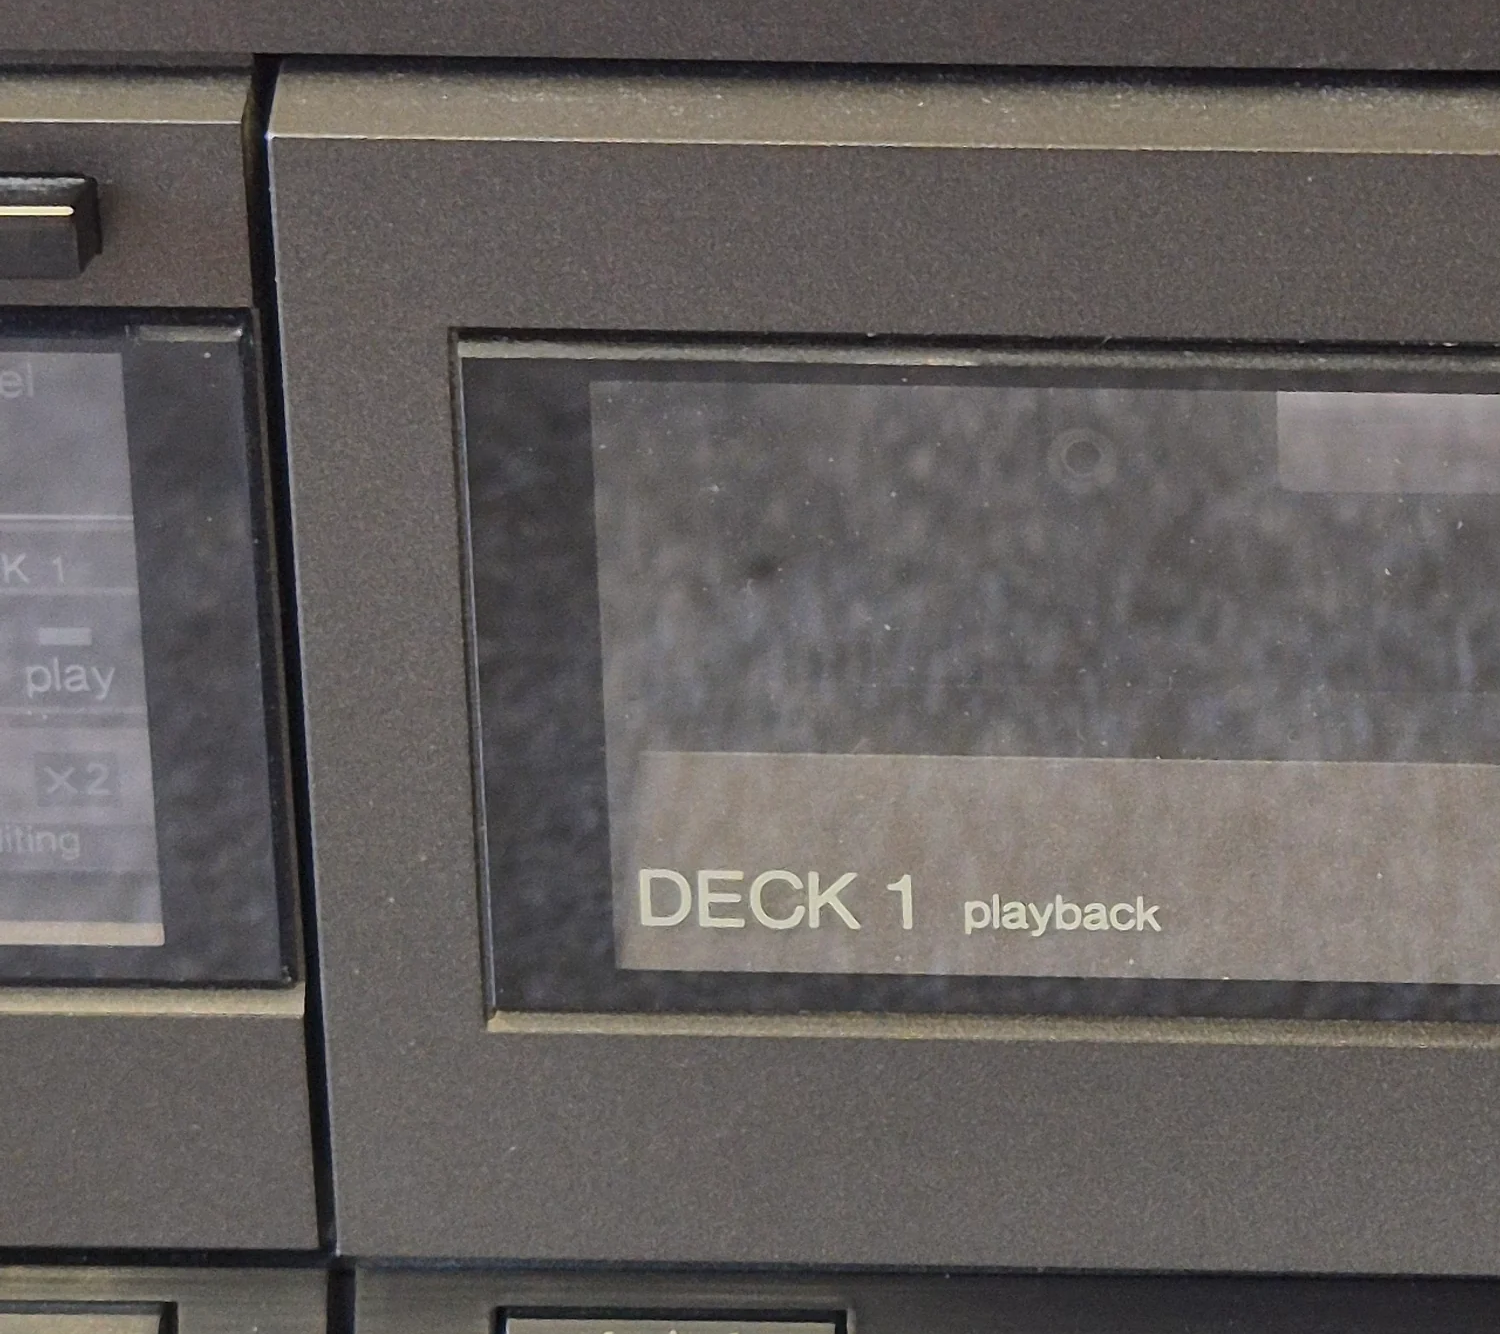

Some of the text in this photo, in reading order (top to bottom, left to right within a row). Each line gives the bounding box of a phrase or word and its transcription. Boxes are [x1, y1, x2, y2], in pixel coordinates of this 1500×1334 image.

[52, 555, 66, 584] 1
[26, 660, 116, 699] play
[0, 824, 81, 861] iting
[639, 868, 1162, 937] DECK 1 playback
